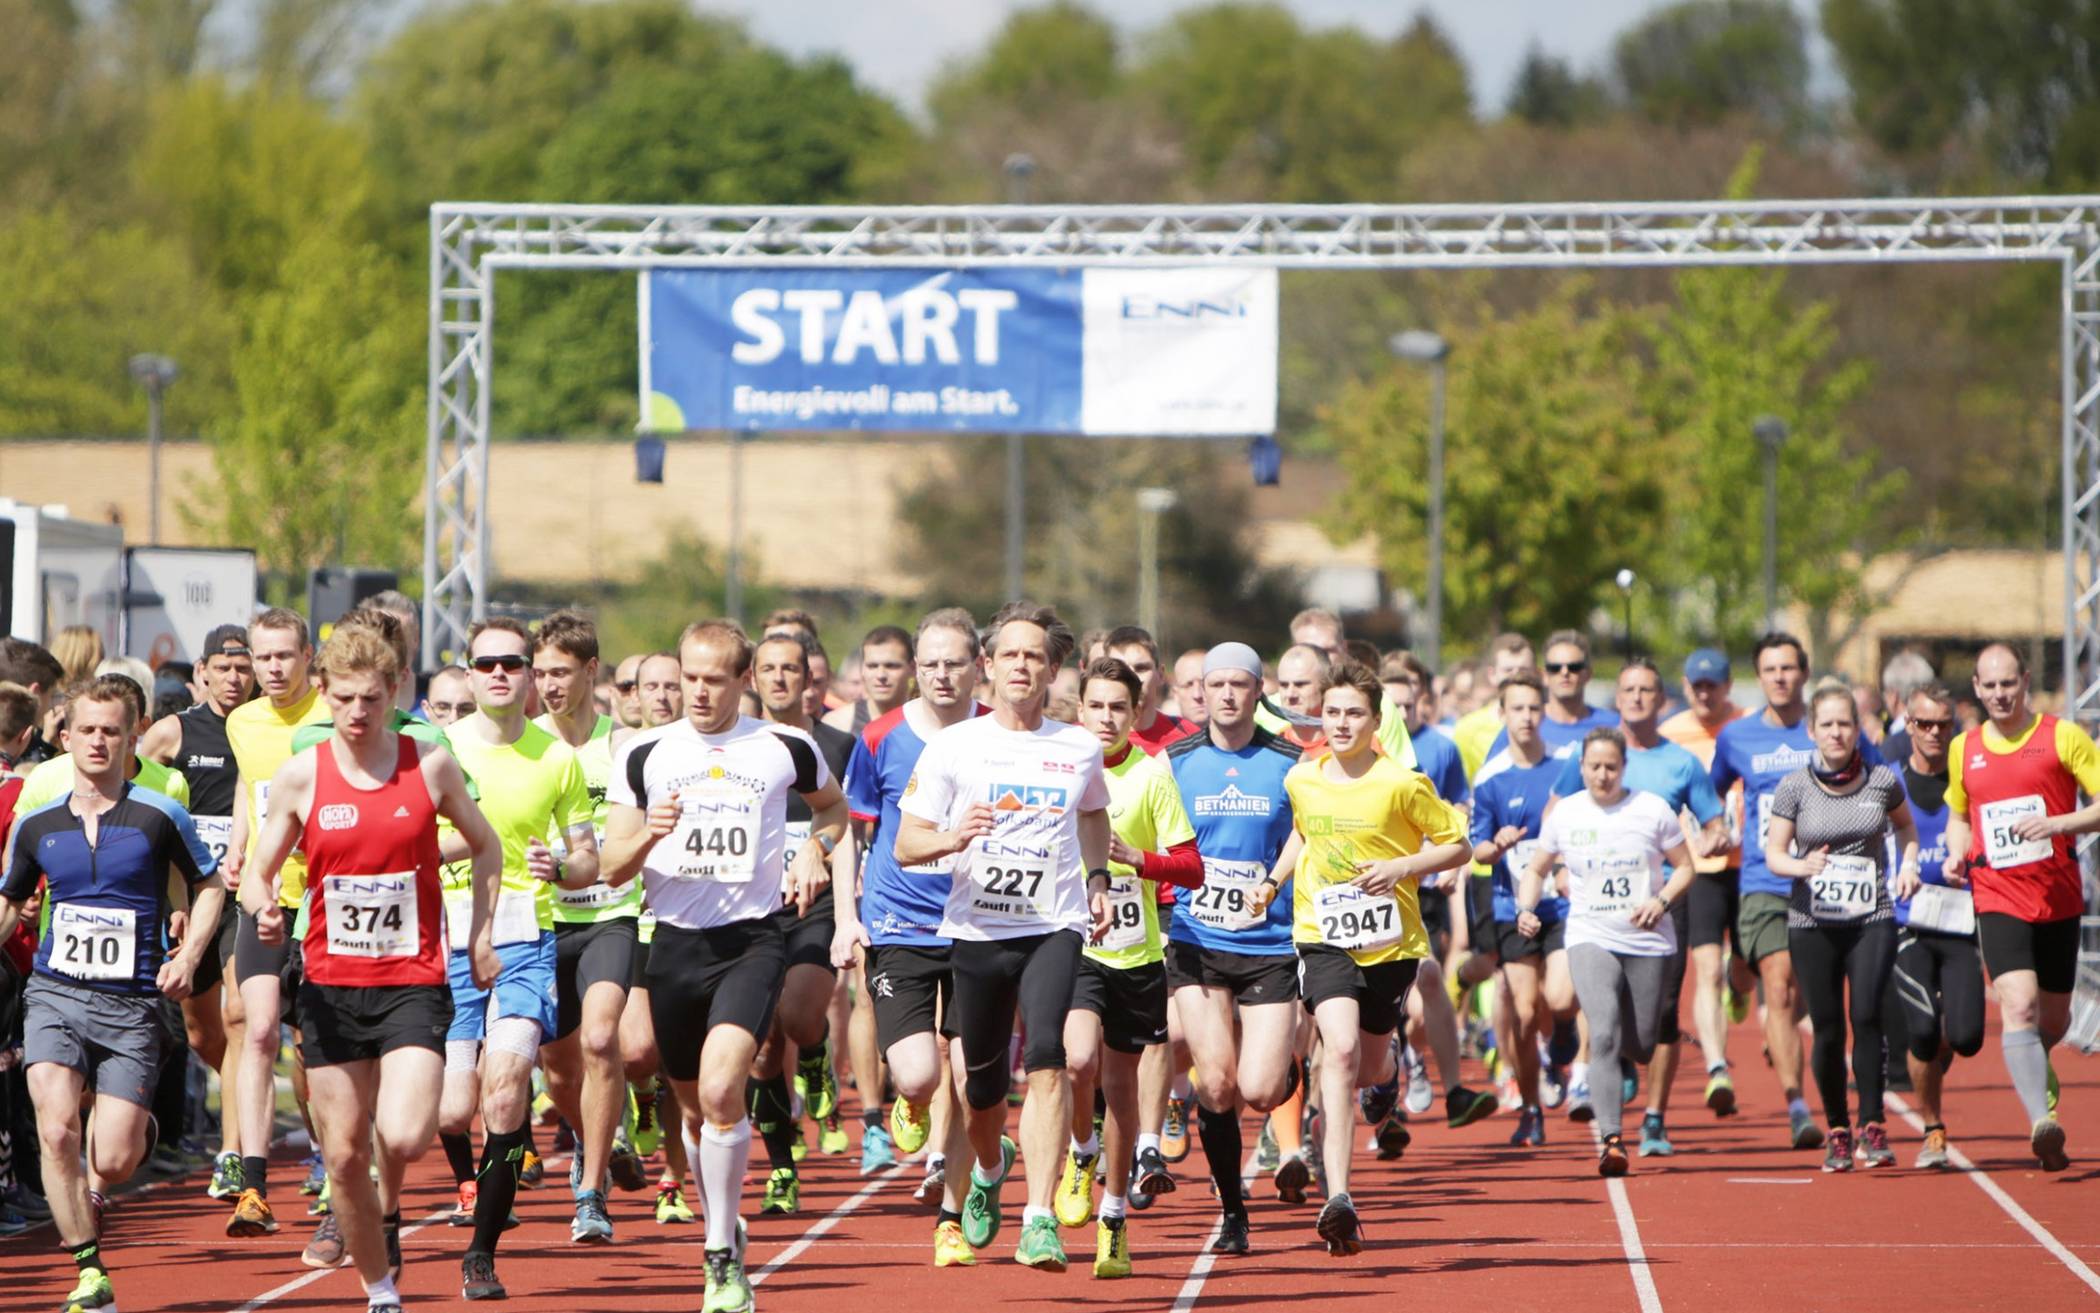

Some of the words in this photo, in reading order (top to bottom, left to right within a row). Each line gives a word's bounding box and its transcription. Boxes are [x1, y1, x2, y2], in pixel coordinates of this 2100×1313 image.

[731, 288, 1018, 365] START
[733, 385, 890, 419] Energievoll
[892, 390, 937, 414] am
[940, 386, 1019, 416] Start.
[1194, 799, 1270, 812] BETHANIEN
[685, 827, 748, 857] 440
[983, 866, 1044, 897] 227
[1601, 877, 1632, 898] 43
[1814, 881, 1873, 903] 2570
[1194, 883, 1245, 912] 279
[342, 904, 403, 934] 374
[1322, 903, 1394, 941] 2947
[65, 934, 120, 965] 210
